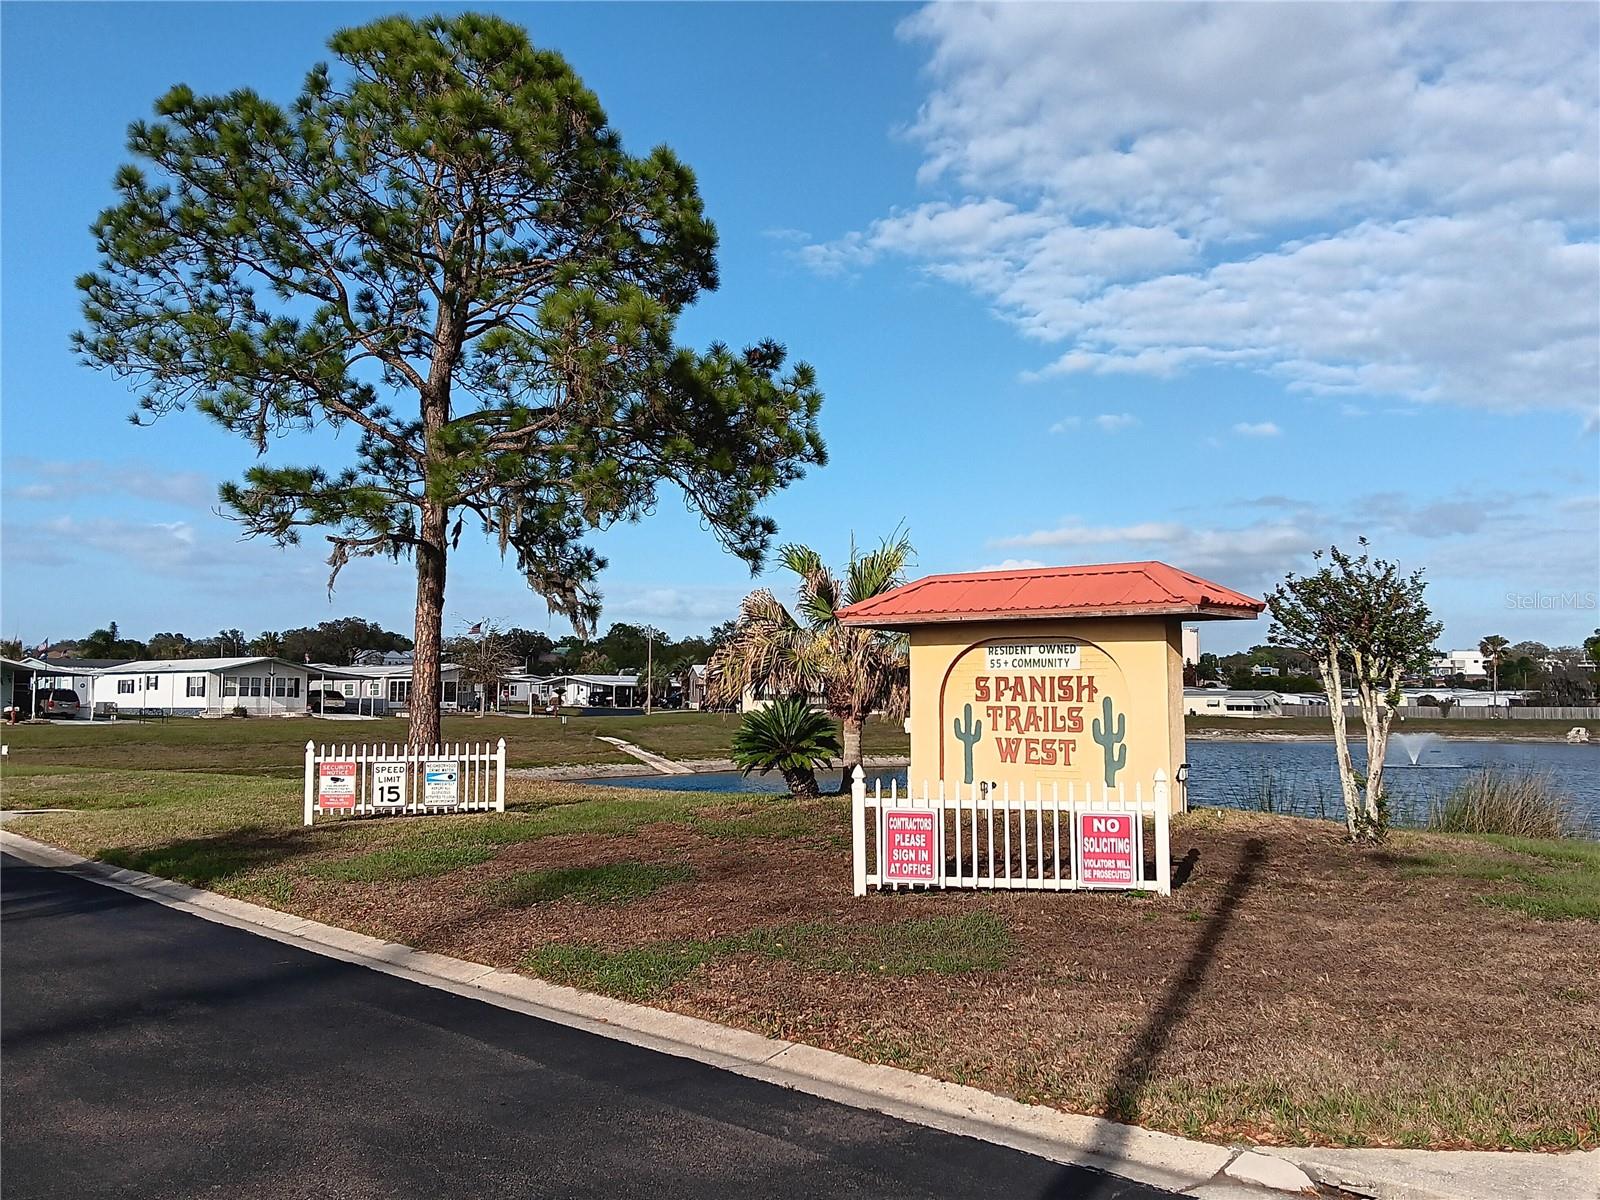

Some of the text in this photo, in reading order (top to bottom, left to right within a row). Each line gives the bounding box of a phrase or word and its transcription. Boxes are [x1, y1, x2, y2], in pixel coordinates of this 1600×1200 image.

[988, 644, 1077, 656] RESIDENT OWNED
[990, 658, 1070, 669] 55+ COMMUNITY
[975, 675, 1099, 703] SPANISH
[986, 705, 1084, 734] TRAILS
[995, 737, 1077, 766] WEST
[375, 766, 405, 774] SPEED
[378, 786, 401, 803] 15
[889, 816, 932, 831] CONTRACTORS
[1092, 818, 1120, 833] NO
[894, 833, 926, 847] PLEASE
[1083, 836, 1130, 854] SOLICITING
[892, 848, 929, 862] SIGN IN
[889, 863, 932, 875] AT OFFICE
[1083, 858, 1131, 869] VIOLATORS WILL
[1084, 868, 1131, 880] BE PROSECUTED
